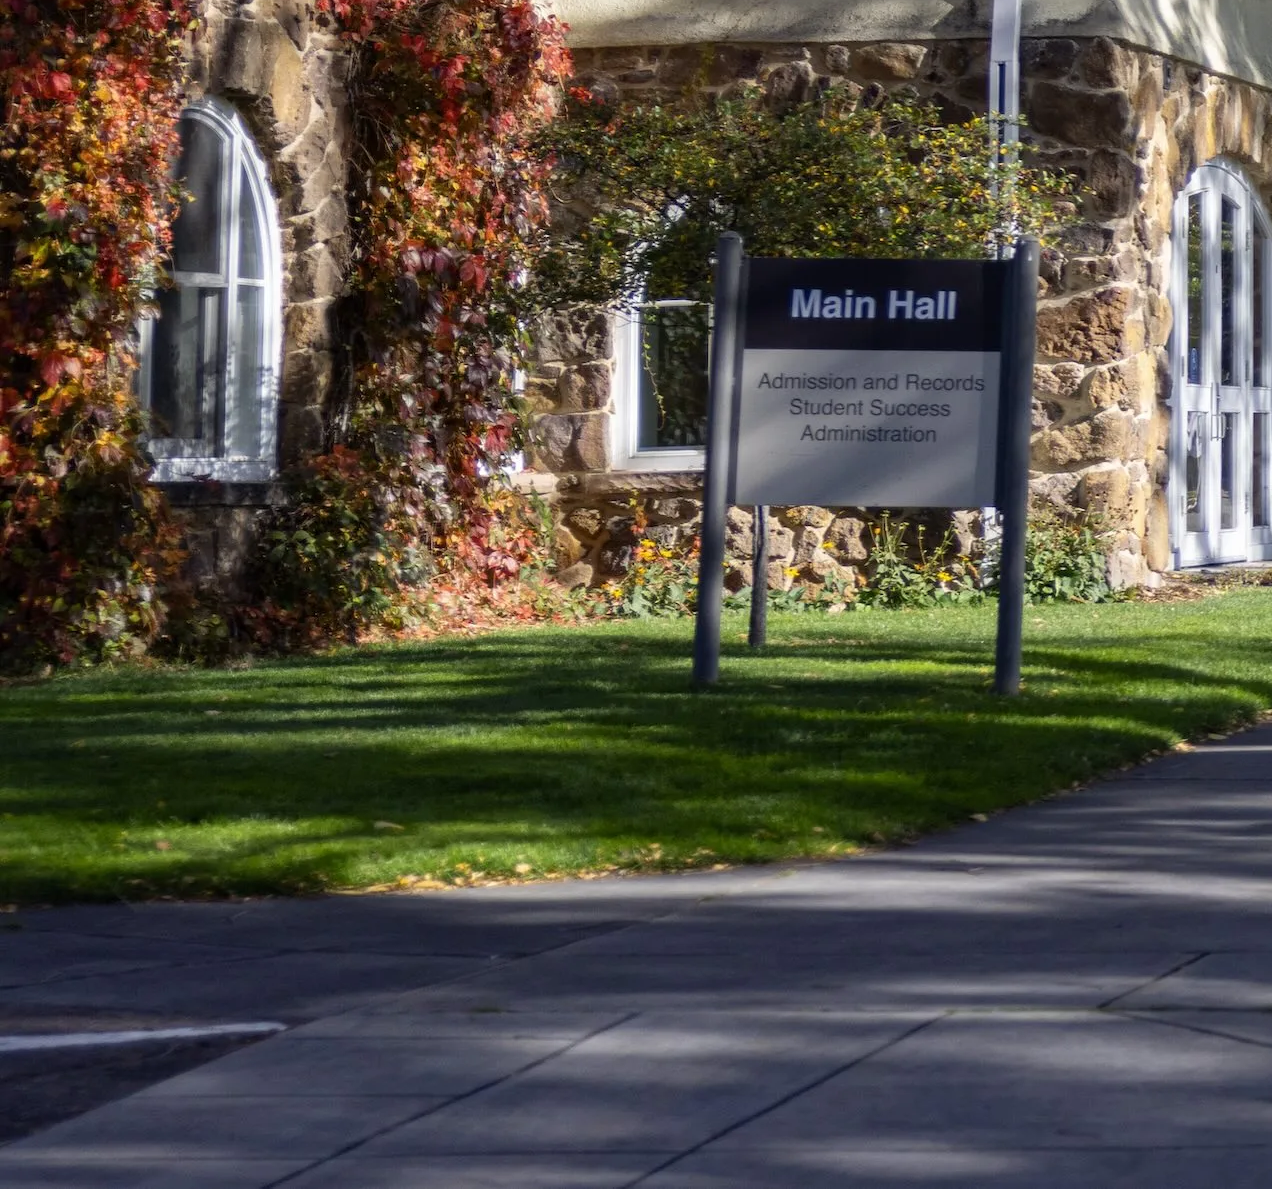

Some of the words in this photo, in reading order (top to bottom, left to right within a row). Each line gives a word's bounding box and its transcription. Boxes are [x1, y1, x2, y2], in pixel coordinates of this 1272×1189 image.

[791, 288, 876, 319] Main
[888, 289, 957, 320] Hall
[757, 372, 857, 390] Admission
[863, 374, 899, 391] and
[905, 373, 986, 392] Records
[789, 397, 864, 416] Student
[870, 398, 951, 417] Success
[799, 423, 938, 443] Administration
